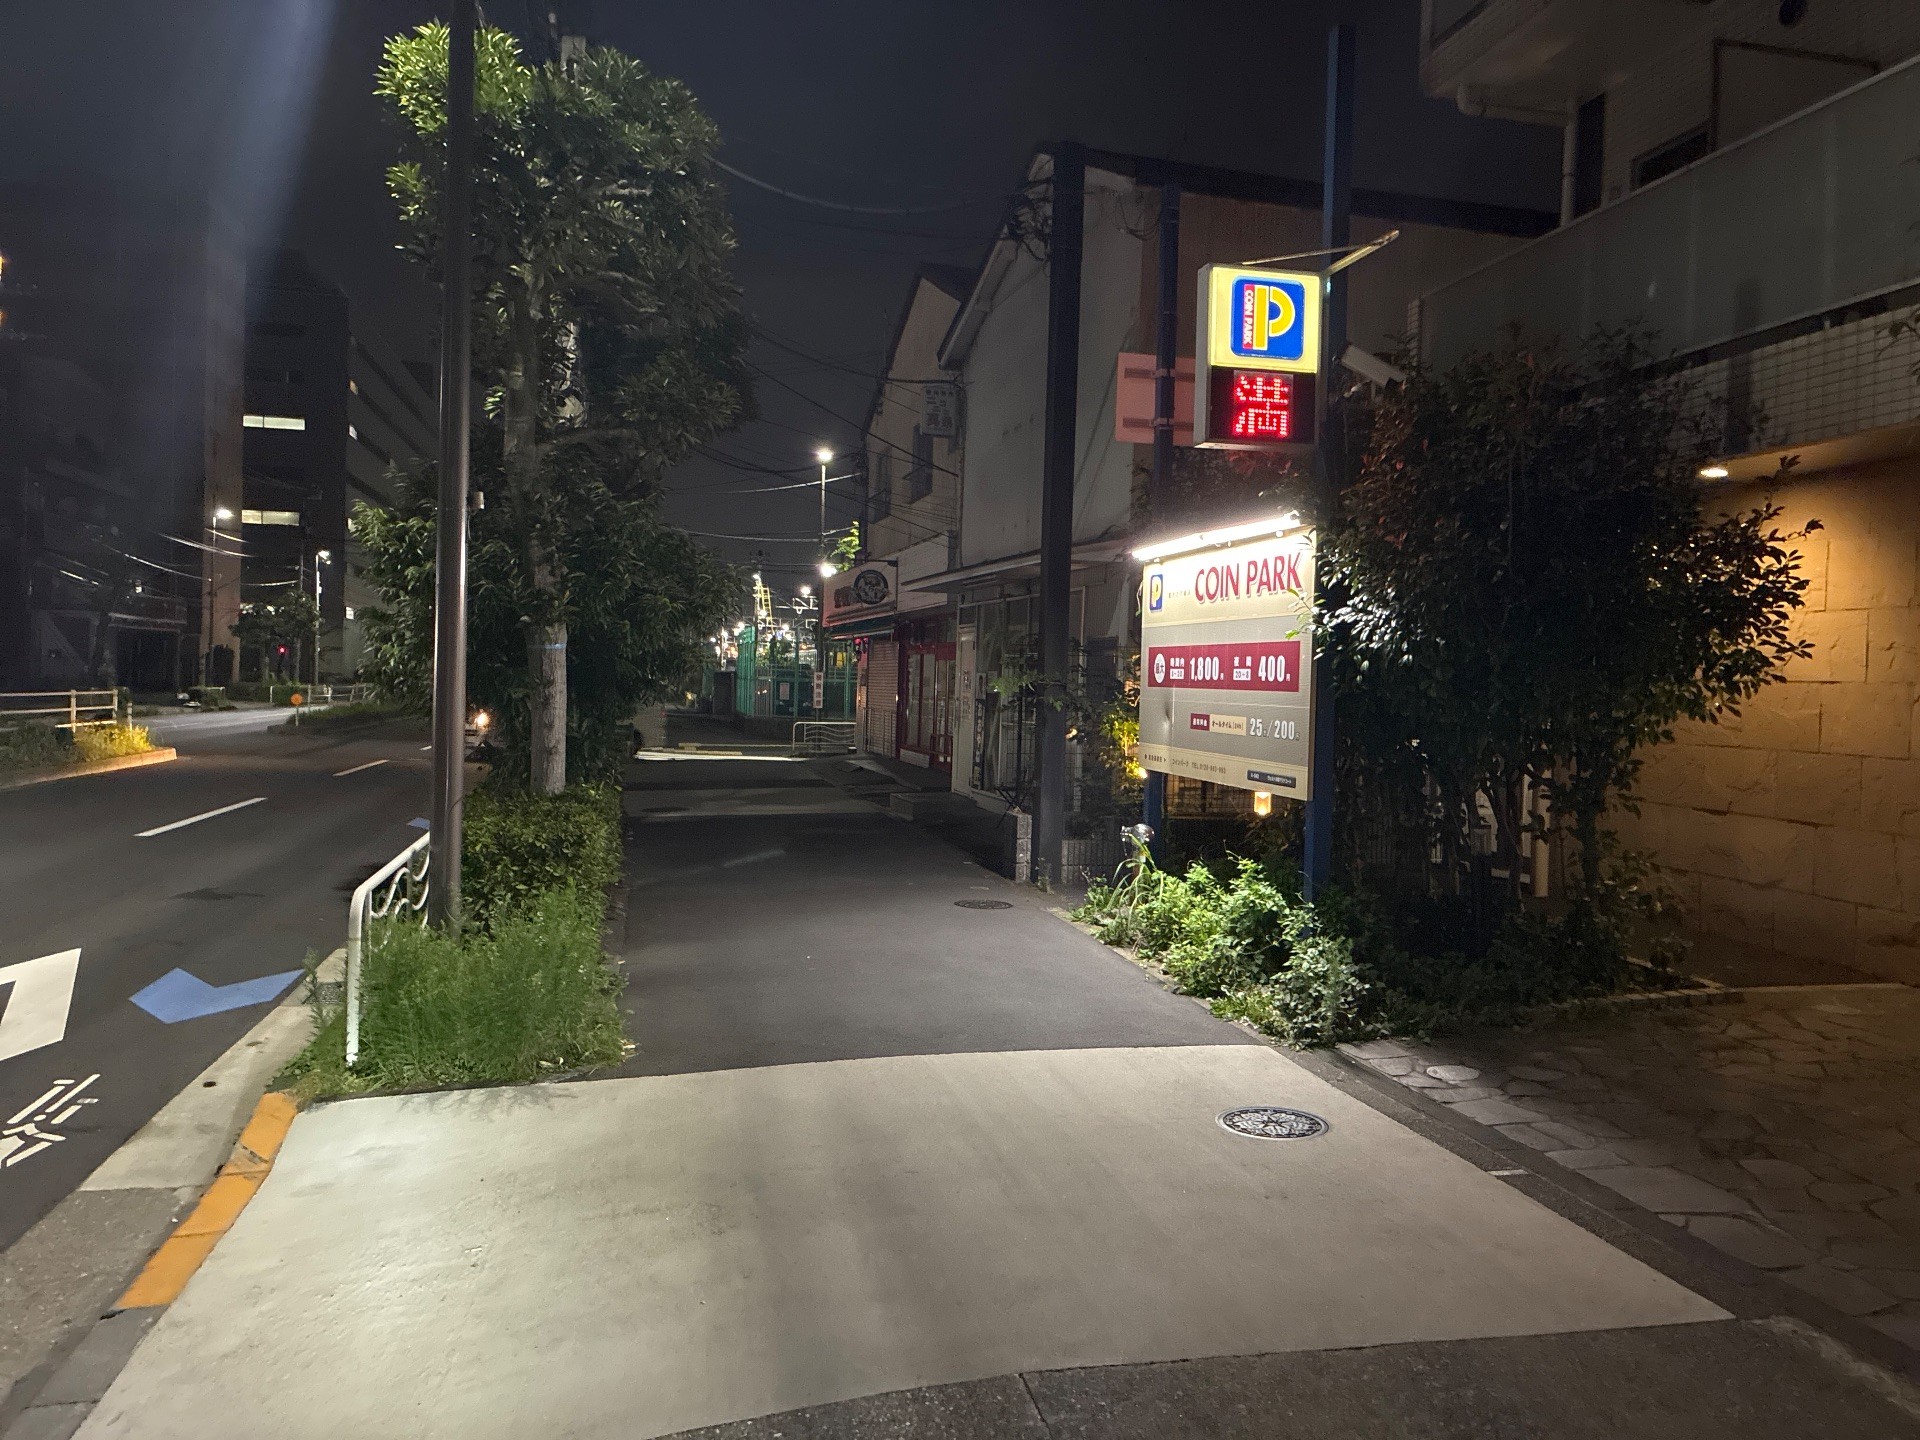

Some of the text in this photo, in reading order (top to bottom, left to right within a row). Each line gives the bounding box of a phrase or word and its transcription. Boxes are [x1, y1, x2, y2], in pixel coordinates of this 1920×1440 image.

[1242, 289, 1254, 345] COIN PARK
[1253, 284, 1296, 350] P
[1235, 375, 1289, 435] 満
[1151, 575, 1163, 609] P
[1195, 551, 1303, 602] COIN PARK
